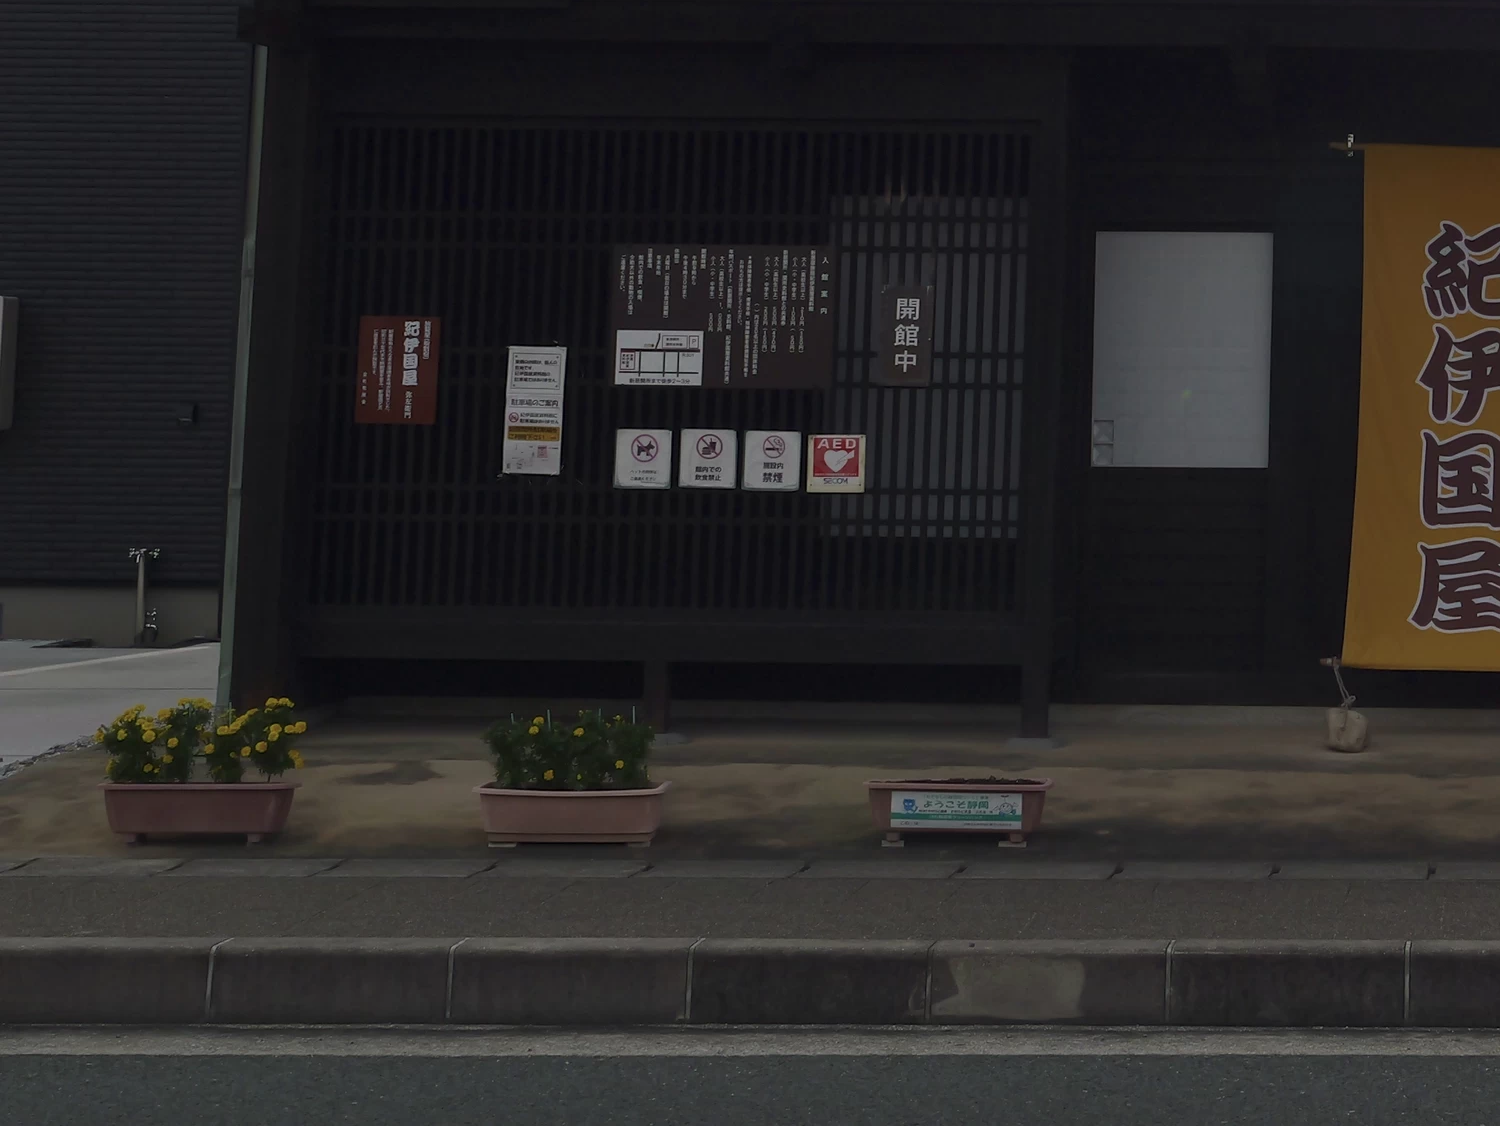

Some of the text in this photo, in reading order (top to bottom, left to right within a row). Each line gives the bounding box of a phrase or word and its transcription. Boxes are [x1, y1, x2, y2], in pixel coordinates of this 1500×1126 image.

[820, 256, 829, 314] 入館案内
[894, 298, 921, 373] 開館中
[402, 321, 421, 386] 紀伊国屋
[818, 439, 857, 449] AED
[695, 474, 722, 482] 飲食禁止
[763, 472, 783, 483] 禁煙
[924, 800, 989, 809] ようこそ静岡
